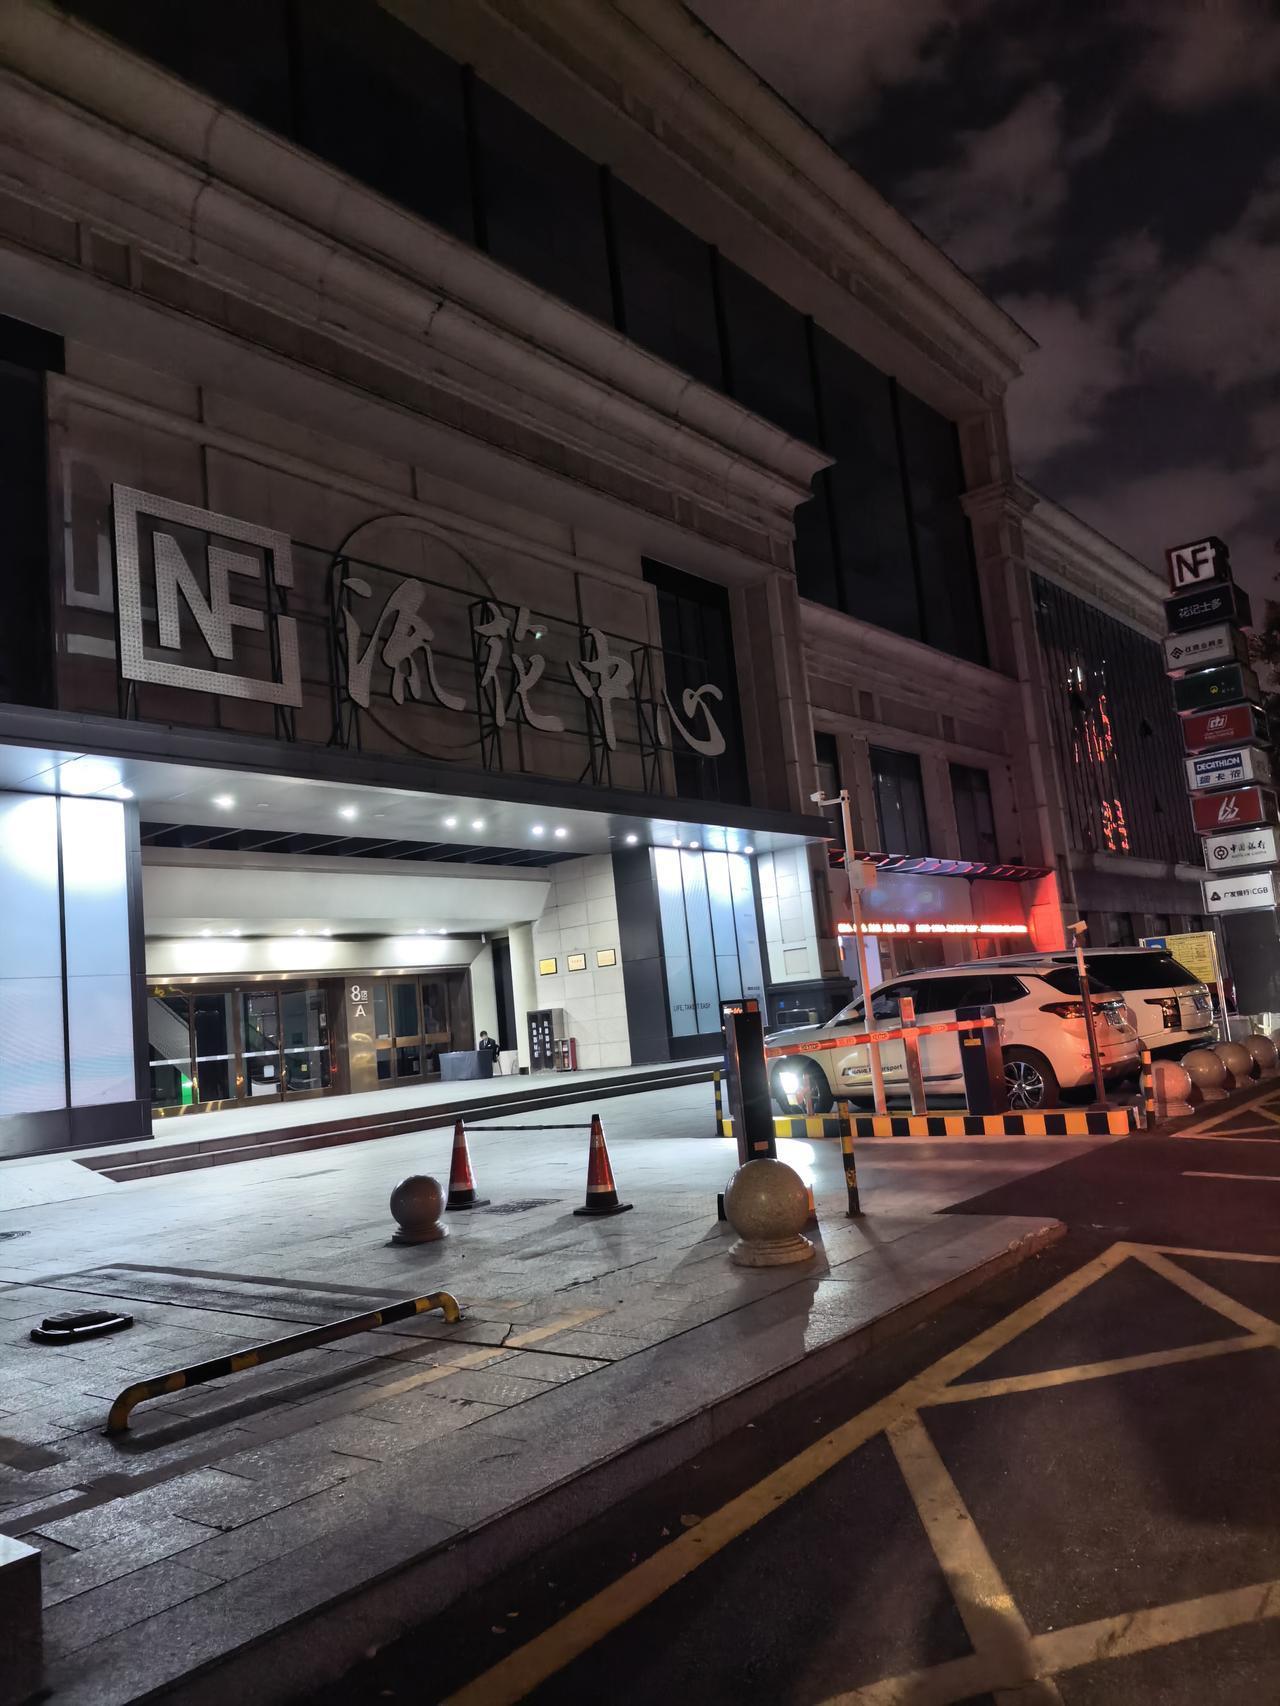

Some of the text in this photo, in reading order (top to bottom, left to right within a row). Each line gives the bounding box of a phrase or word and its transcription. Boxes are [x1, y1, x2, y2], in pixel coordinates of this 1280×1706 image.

[1175, 545, 1209, 583] NF
[153, 531, 265, 660] NF
[1178, 598, 1222, 619] 花记士多
[343, 577, 726, 757] 流花中心
[1196, 757, 1240, 771] DECATHLON
[1252, 887, 1269, 895] CGB
[355, 1004, 366, 1017] A
